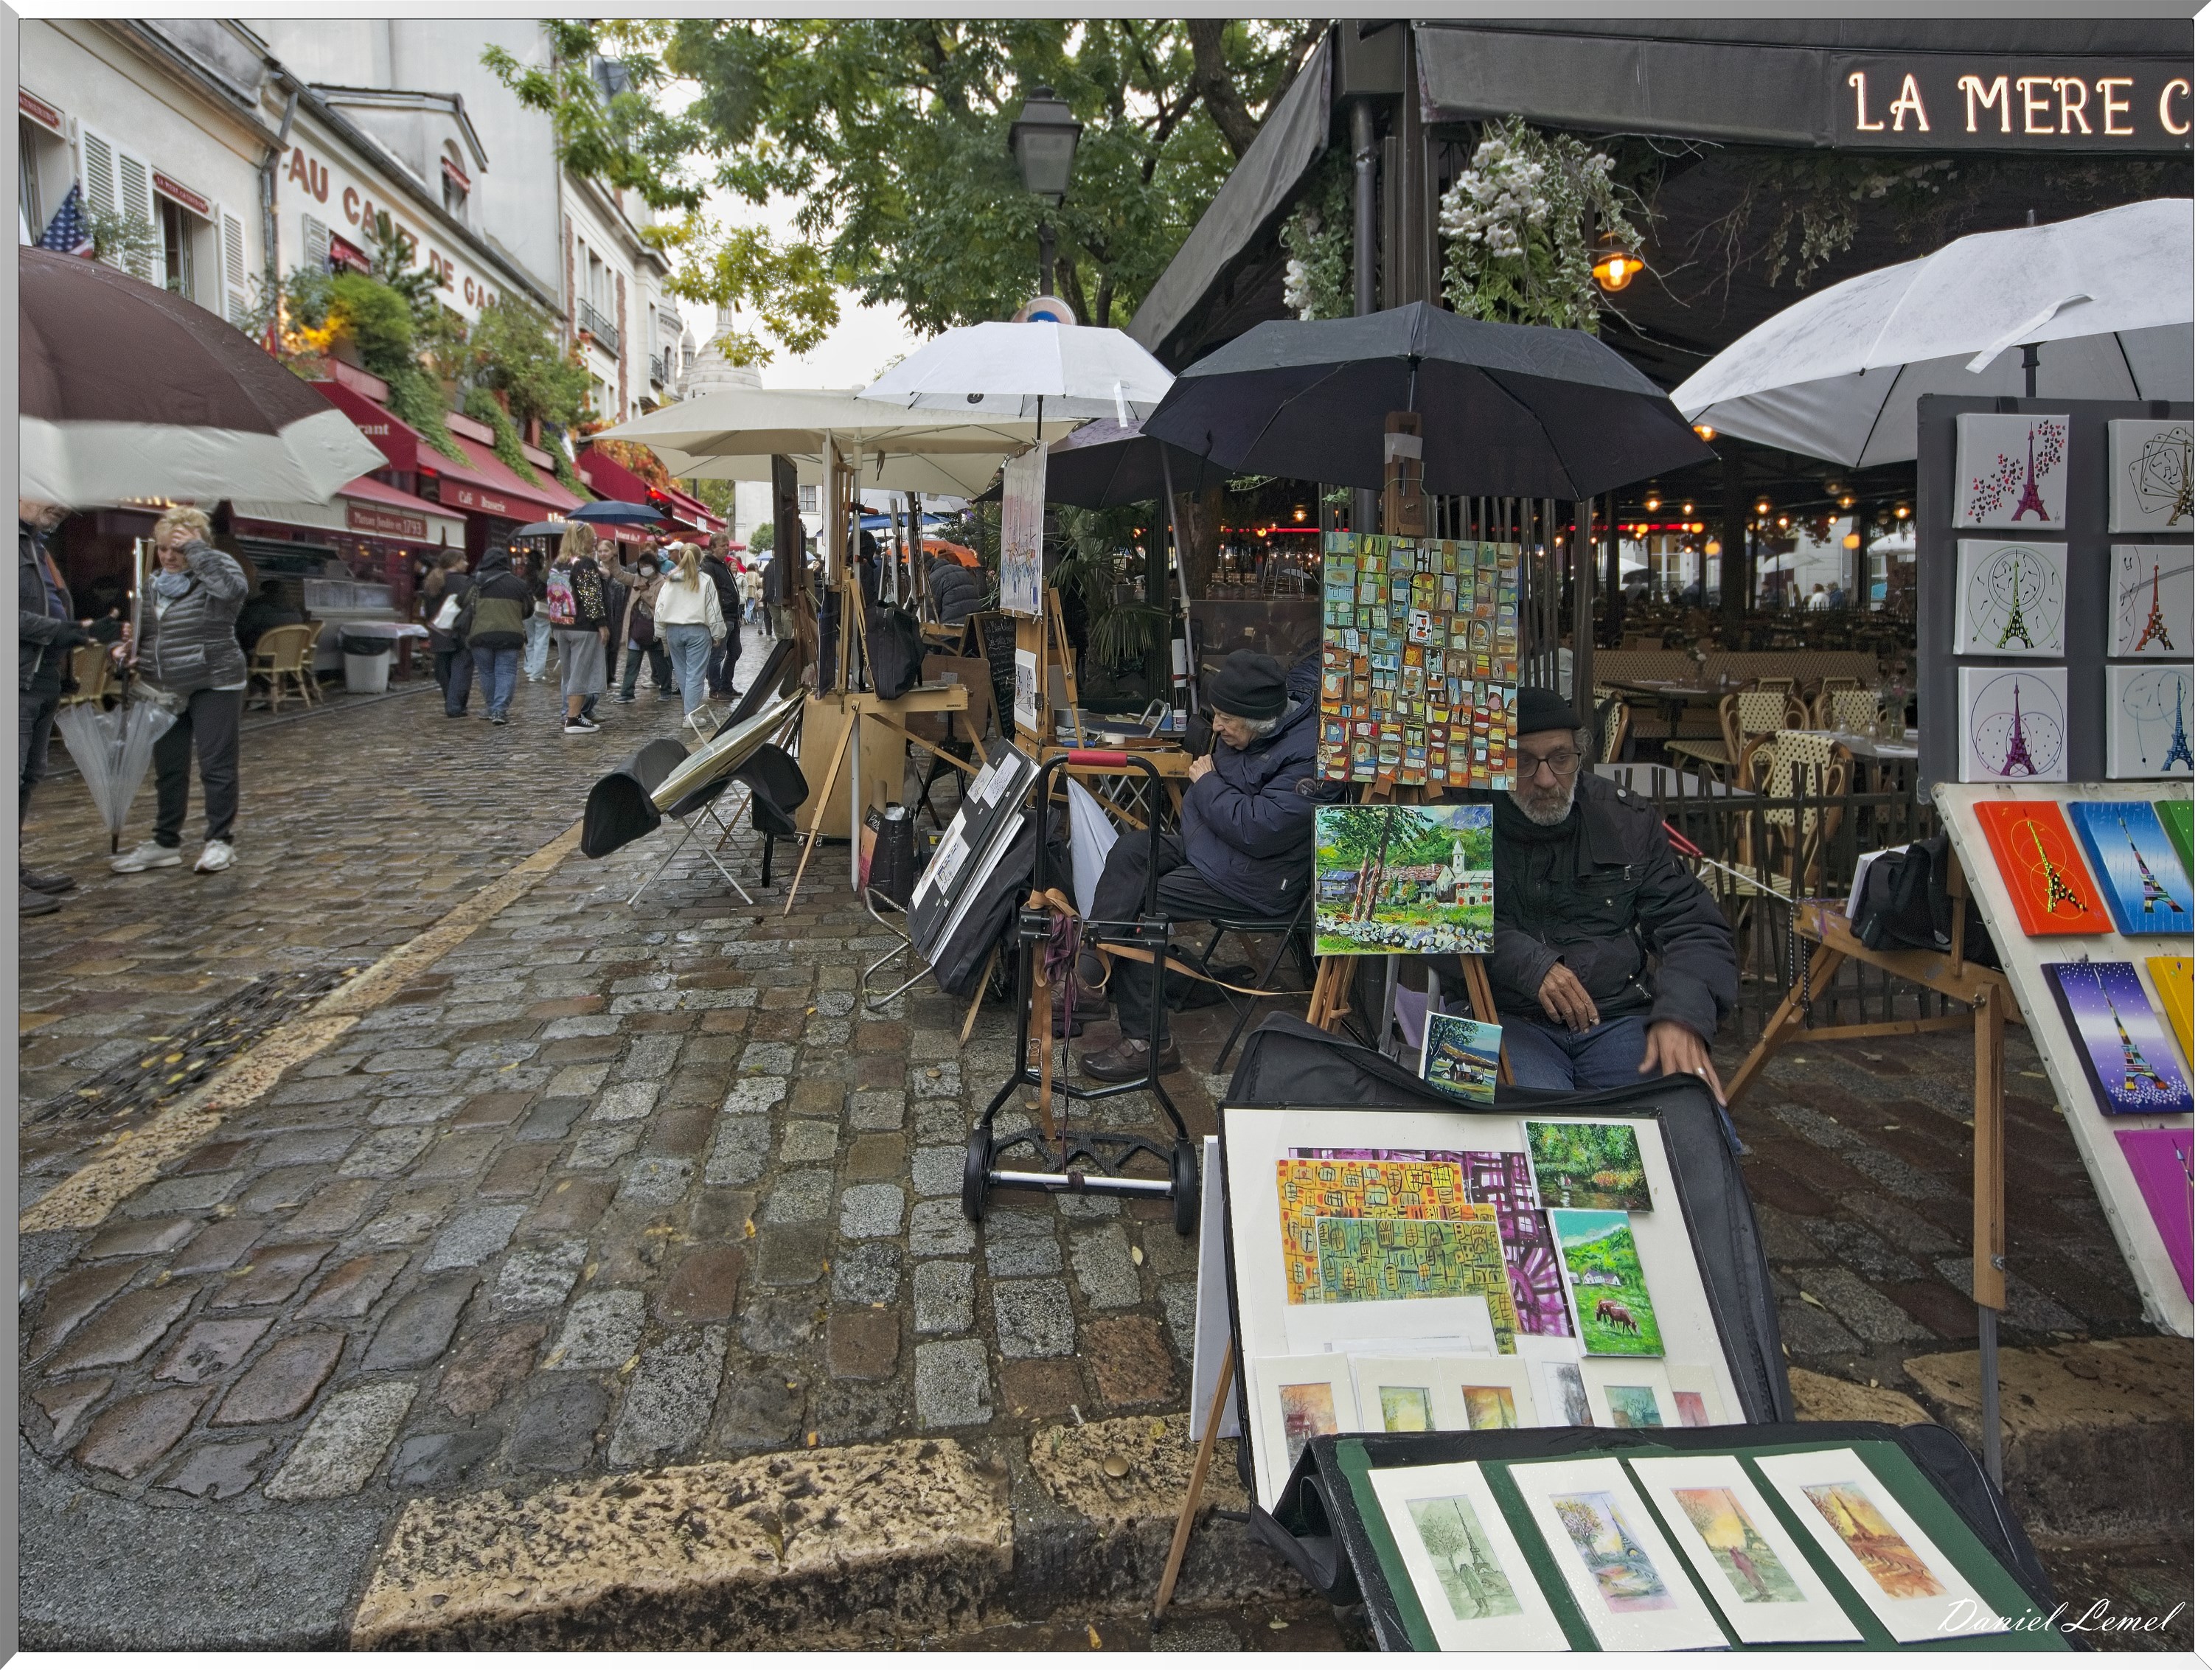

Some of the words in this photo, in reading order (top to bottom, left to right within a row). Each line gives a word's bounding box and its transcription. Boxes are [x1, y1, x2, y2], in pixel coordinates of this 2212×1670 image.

[1848, 72, 1930, 131] LA
[1958, 74, 2133, 134] MERE
[288, 147, 329, 203] AU
[429, 248, 454, 293] DE
[403, 519, 422, 535] 1793
